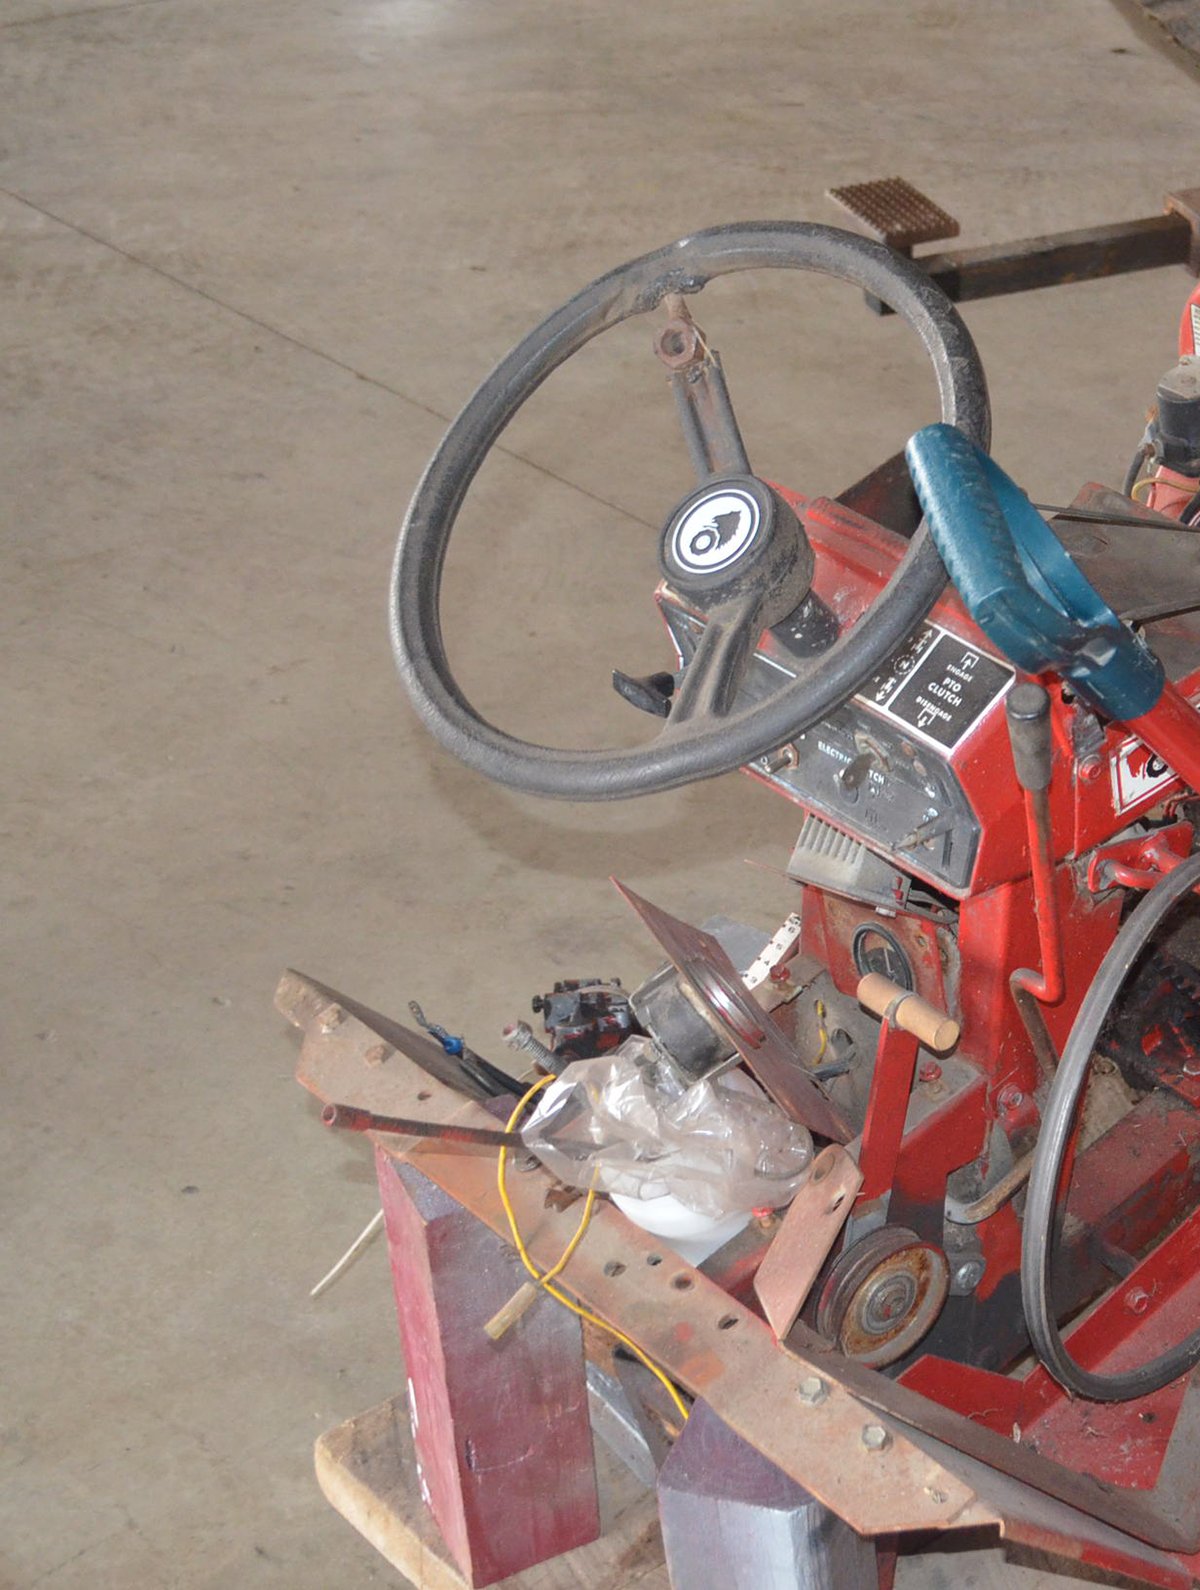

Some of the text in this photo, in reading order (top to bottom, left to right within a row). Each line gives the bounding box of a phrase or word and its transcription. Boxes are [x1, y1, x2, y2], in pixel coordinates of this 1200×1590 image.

[942, 677, 962, 692] PTO
[946, 663, 973, 682] ENGAGE
[928, 682, 962, 707] CLUTCH
[915, 695, 952, 722] DISENGAGE
[817, 740, 853, 764] ELECTRIC
